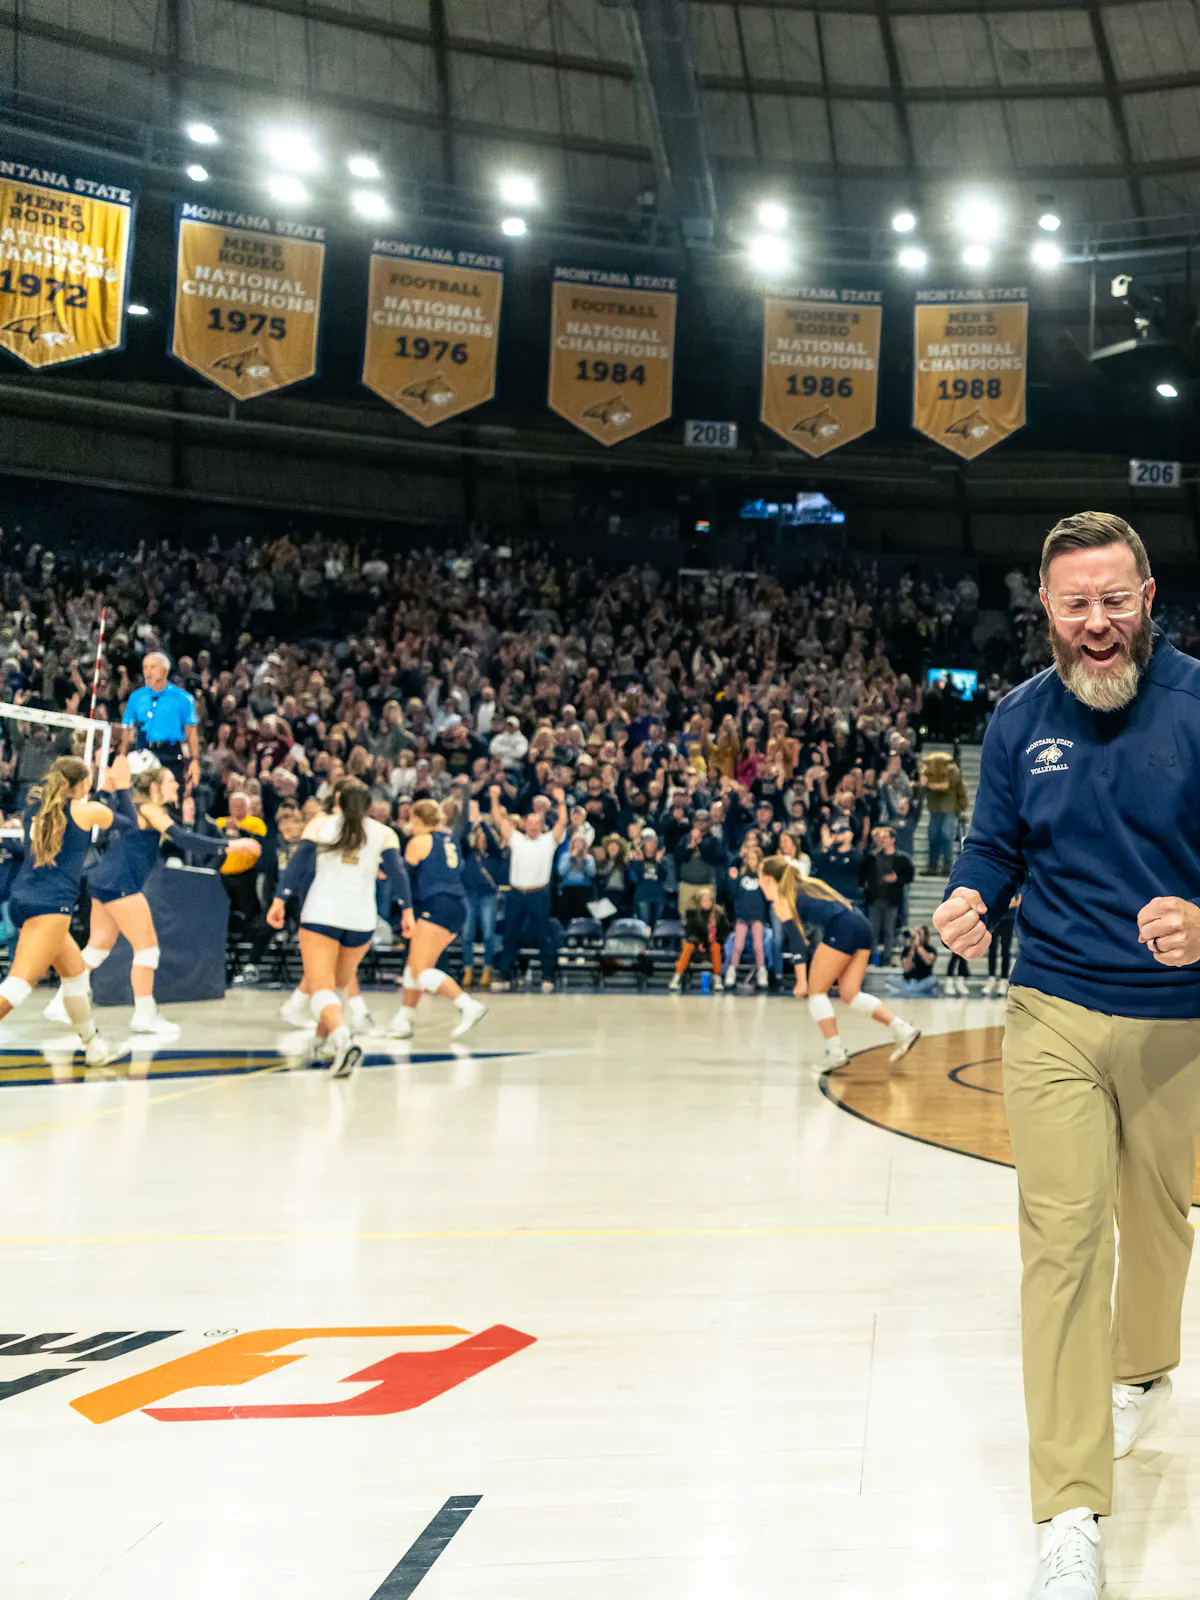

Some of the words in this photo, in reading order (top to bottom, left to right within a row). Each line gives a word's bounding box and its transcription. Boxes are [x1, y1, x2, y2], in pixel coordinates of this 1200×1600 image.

[0, 160, 69, 189] NTANA
[74, 178, 131, 203] STATE
[16, 191, 82, 216] MEN'S
[10, 206, 85, 233] RODEO
[182, 202, 271, 231] MONTANA
[275, 219, 326, 240] STATE
[0, 227, 107, 263] ATIONAL
[224, 235, 283, 257] MEN'S
[372, 238, 454, 261] MONTANA
[457, 251, 503, 268] STATE
[0, 243, 118, 282] AMPIONS
[218, 248, 285, 272] RODEO
[0, 270, 87, 309] 1972
[195, 265, 306, 296] NATIONAL
[390, 272, 481, 297] FOOTBALL
[555, 267, 630, 286] MONTANA
[633, 275, 677, 290] STATE
[182, 279, 315, 313] CHAMPIONS
[841, 288, 881, 302] STATE
[915, 288, 985, 301] MONTANA
[987, 287, 1029, 299] STATE
[383, 295, 484, 321] NATIONAL
[572, 298, 657, 319] FOOTBALL
[786, 309, 860, 324] WOMEN'S
[207, 307, 287, 340] 1975
[372, 310, 493, 338] CHAMPIONS
[566, 321, 660, 342] NATIONAL
[795, 322, 850, 337] RODEO
[944, 325, 998, 337] RODEO
[395, 335, 468, 365] 1976
[557, 335, 669, 359] CHAMPIONS
[776, 338, 867, 356] NATIONAL
[927, 343, 1014, 357] NATIONAL
[575, 359, 647, 385] 1984
[768, 351, 874, 371] CHAMPIONS
[919, 358, 1023, 373] CHAMPIONS
[786, 374, 853, 398] 1986
[938, 378, 1002, 400] 1988
[692, 425, 730, 446] 208
[1137, 463, 1173, 484] 206
[1026, 738, 1056, 755] MONTANA
[1056, 738, 1074, 749] STATE
[1030, 763, 1069, 775] VOLLEYBALL
